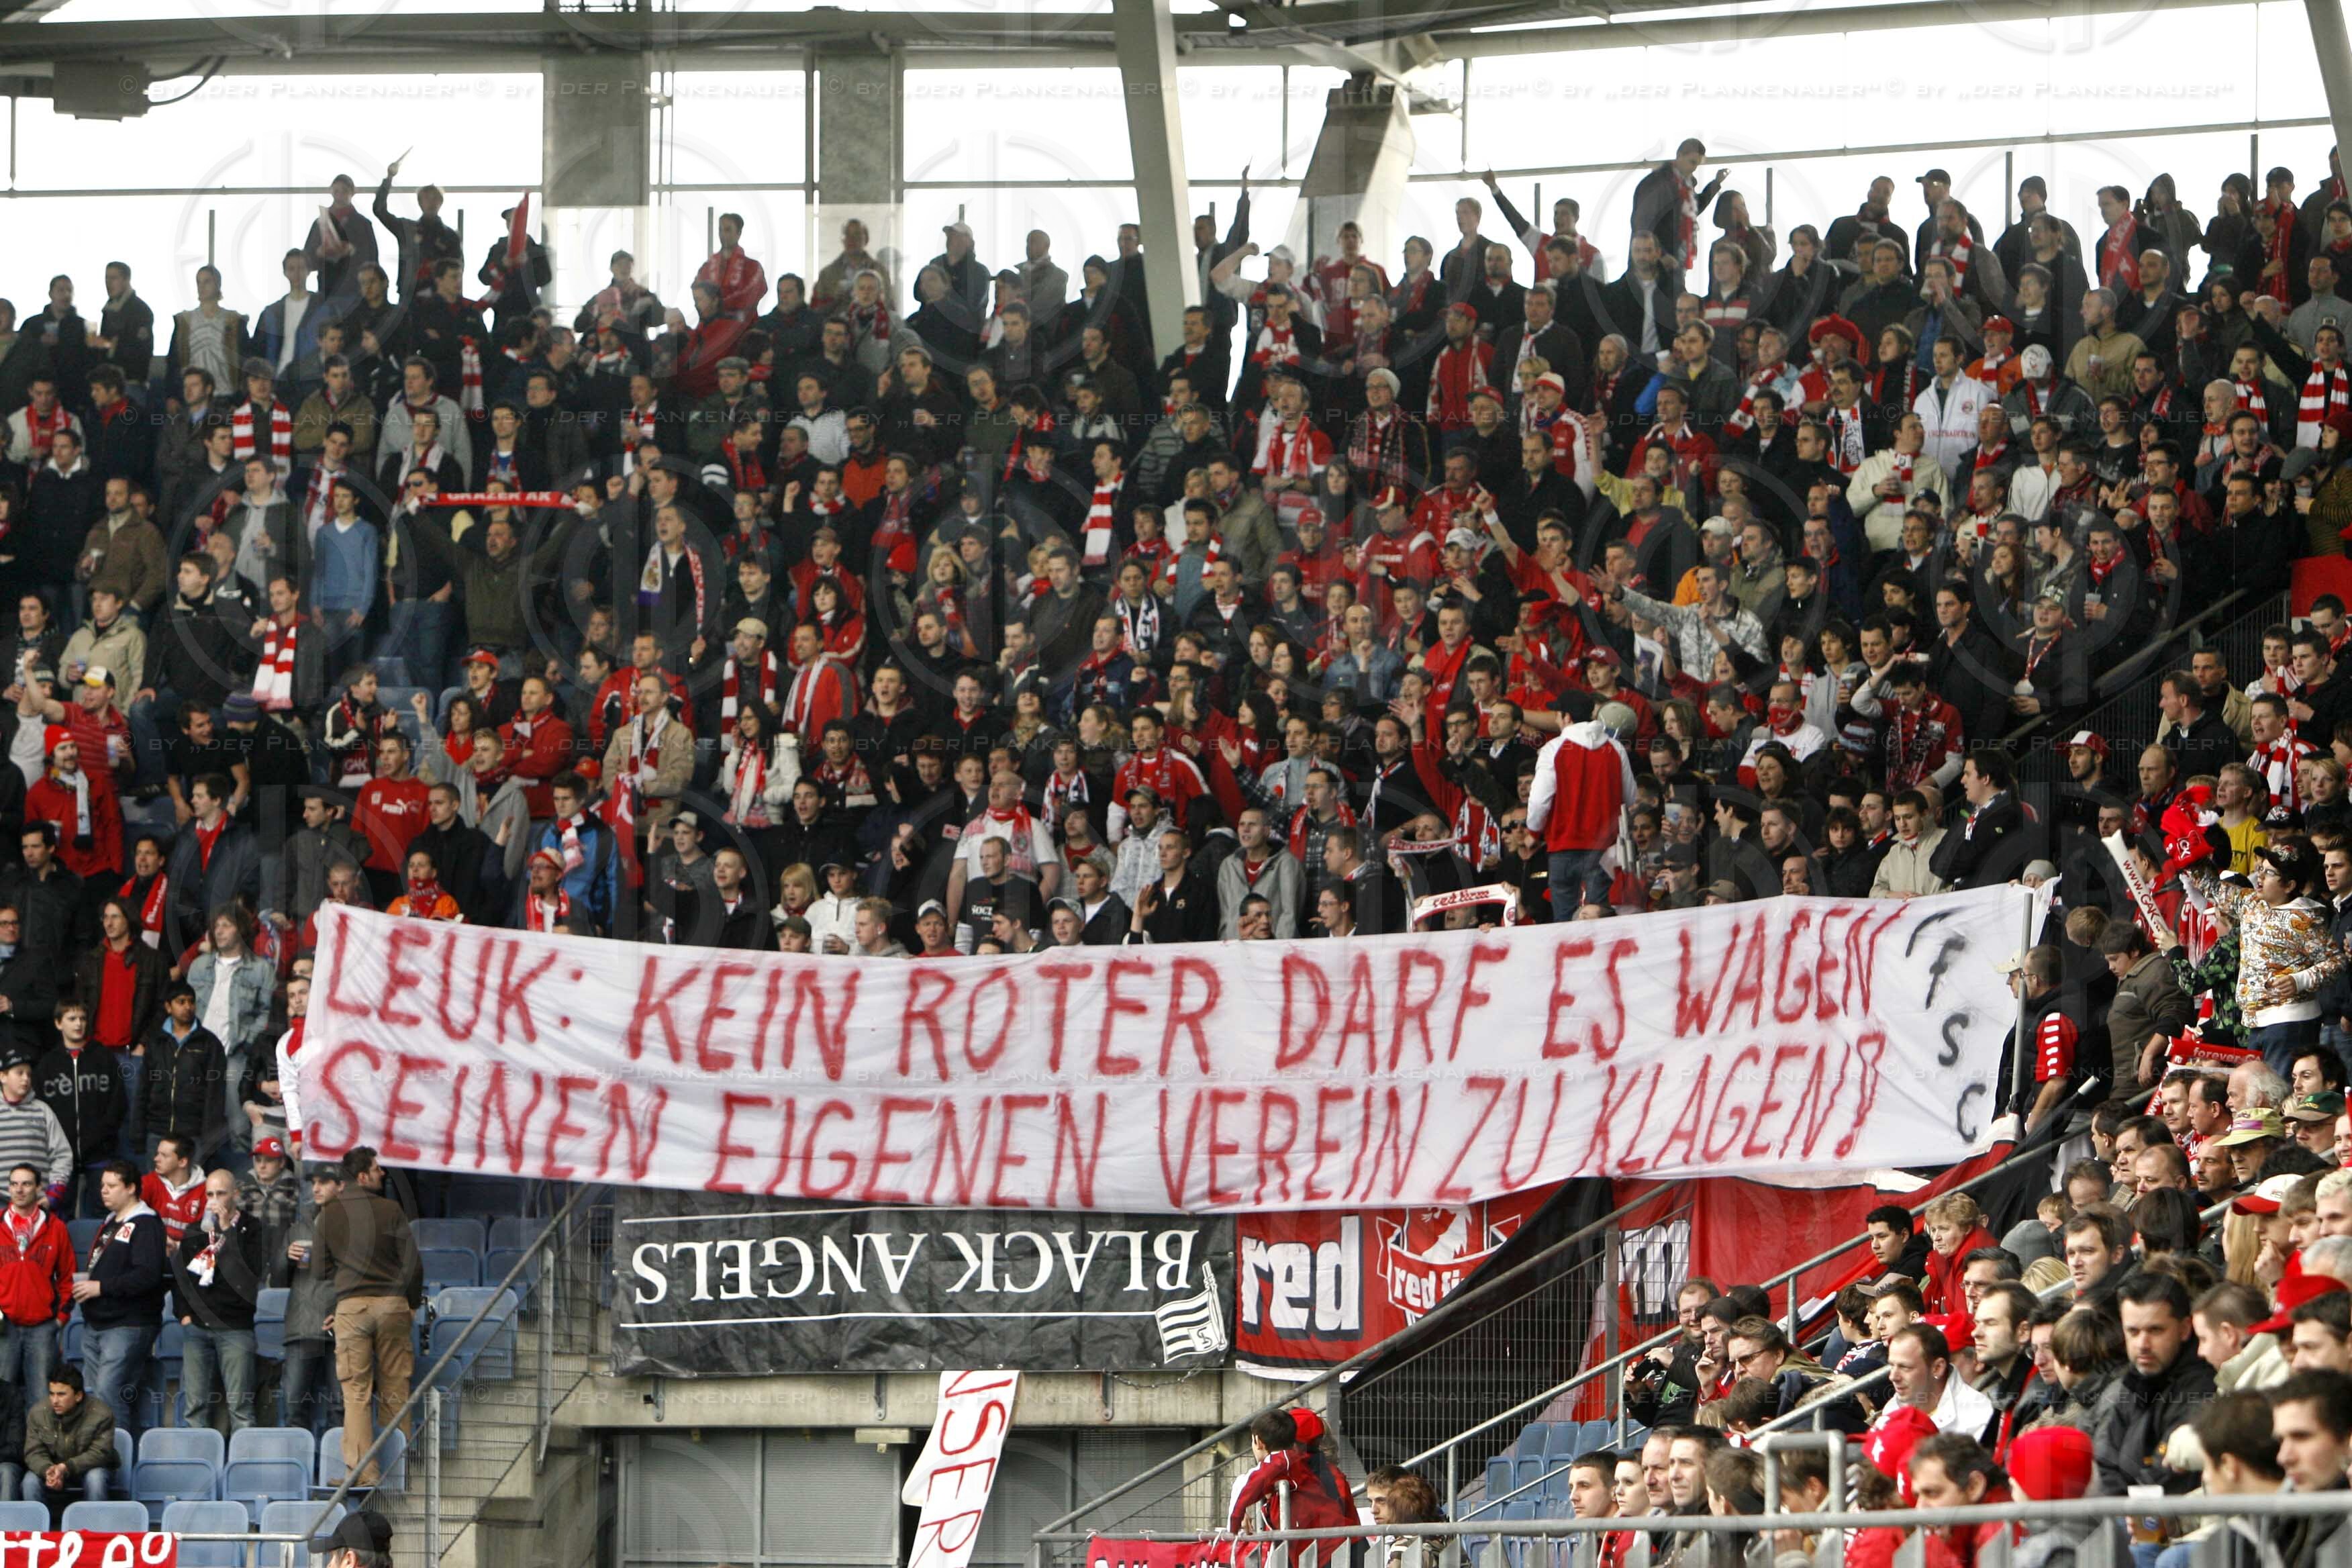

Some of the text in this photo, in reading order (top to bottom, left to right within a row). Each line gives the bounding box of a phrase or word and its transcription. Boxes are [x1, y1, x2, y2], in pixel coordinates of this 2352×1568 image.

[326, 904, 1909, 1081] LEUK: KEIN ROTER DARF ES WAGEN
[309, 1040, 669, 1181] SEINEN
[703, 1091, 1107, 1208] EIGENEN
[1158, 1084, 1430, 1208] VEREIN
[1433, 1071, 1565, 1202] ZU
[632, 1229, 1199, 1305] BLACK ANGELS
[1241, 1216, 1361, 1332] red
[1394, 1266, 1436, 1309] red
